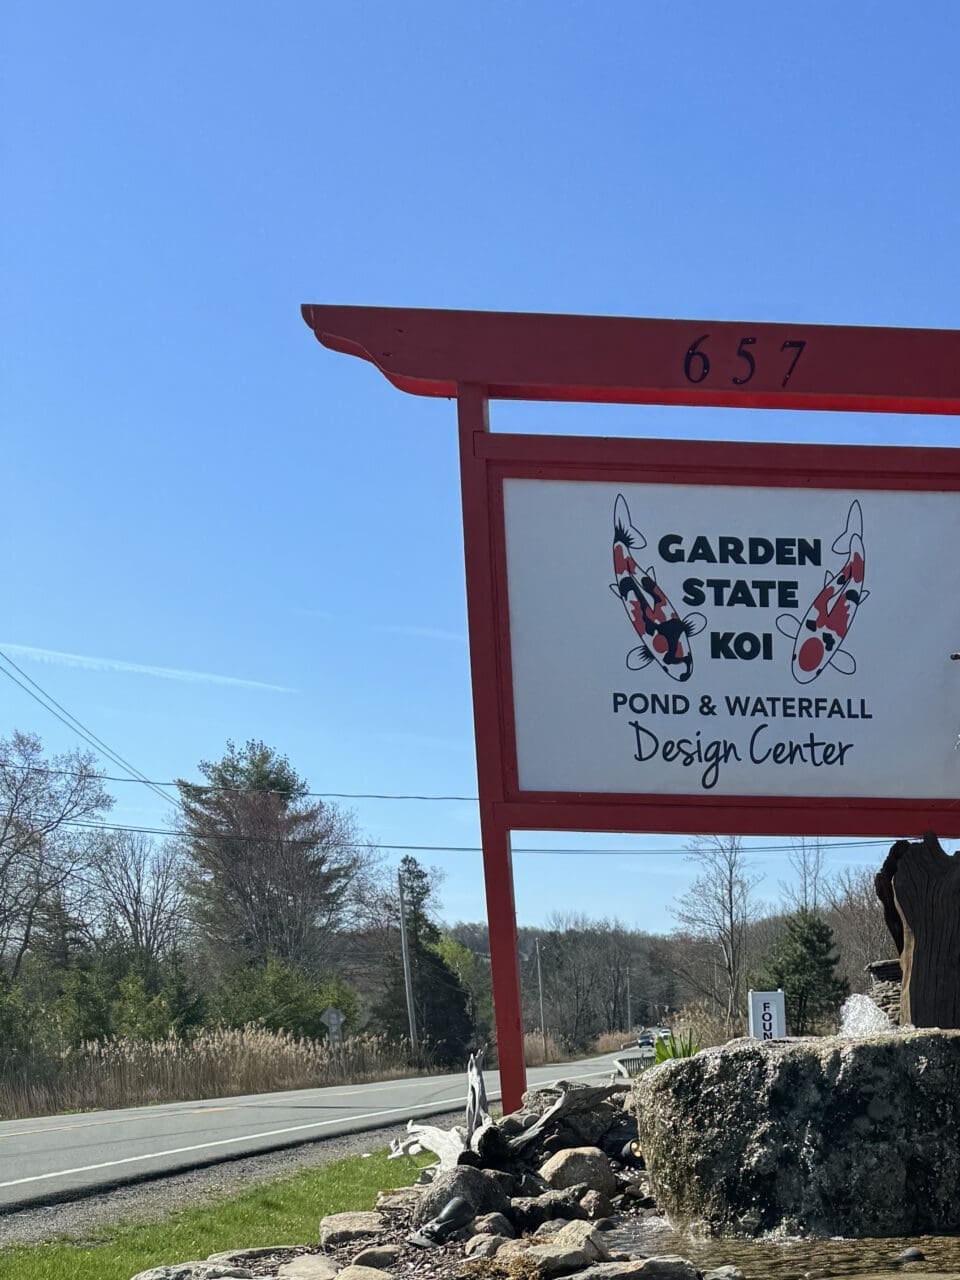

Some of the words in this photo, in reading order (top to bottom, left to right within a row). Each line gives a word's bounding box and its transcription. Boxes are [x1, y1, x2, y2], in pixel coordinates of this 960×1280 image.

[658, 534, 821, 566] GARDEN
[682, 578, 799, 608] STATE
[711, 632, 773, 660] KOI
[613, 693, 690, 716] POND
[699, 695, 718, 716] &
[725, 696, 873, 720] WATERFALL
[630, 720, 741, 789] Design
[749, 723, 855, 767] Center
